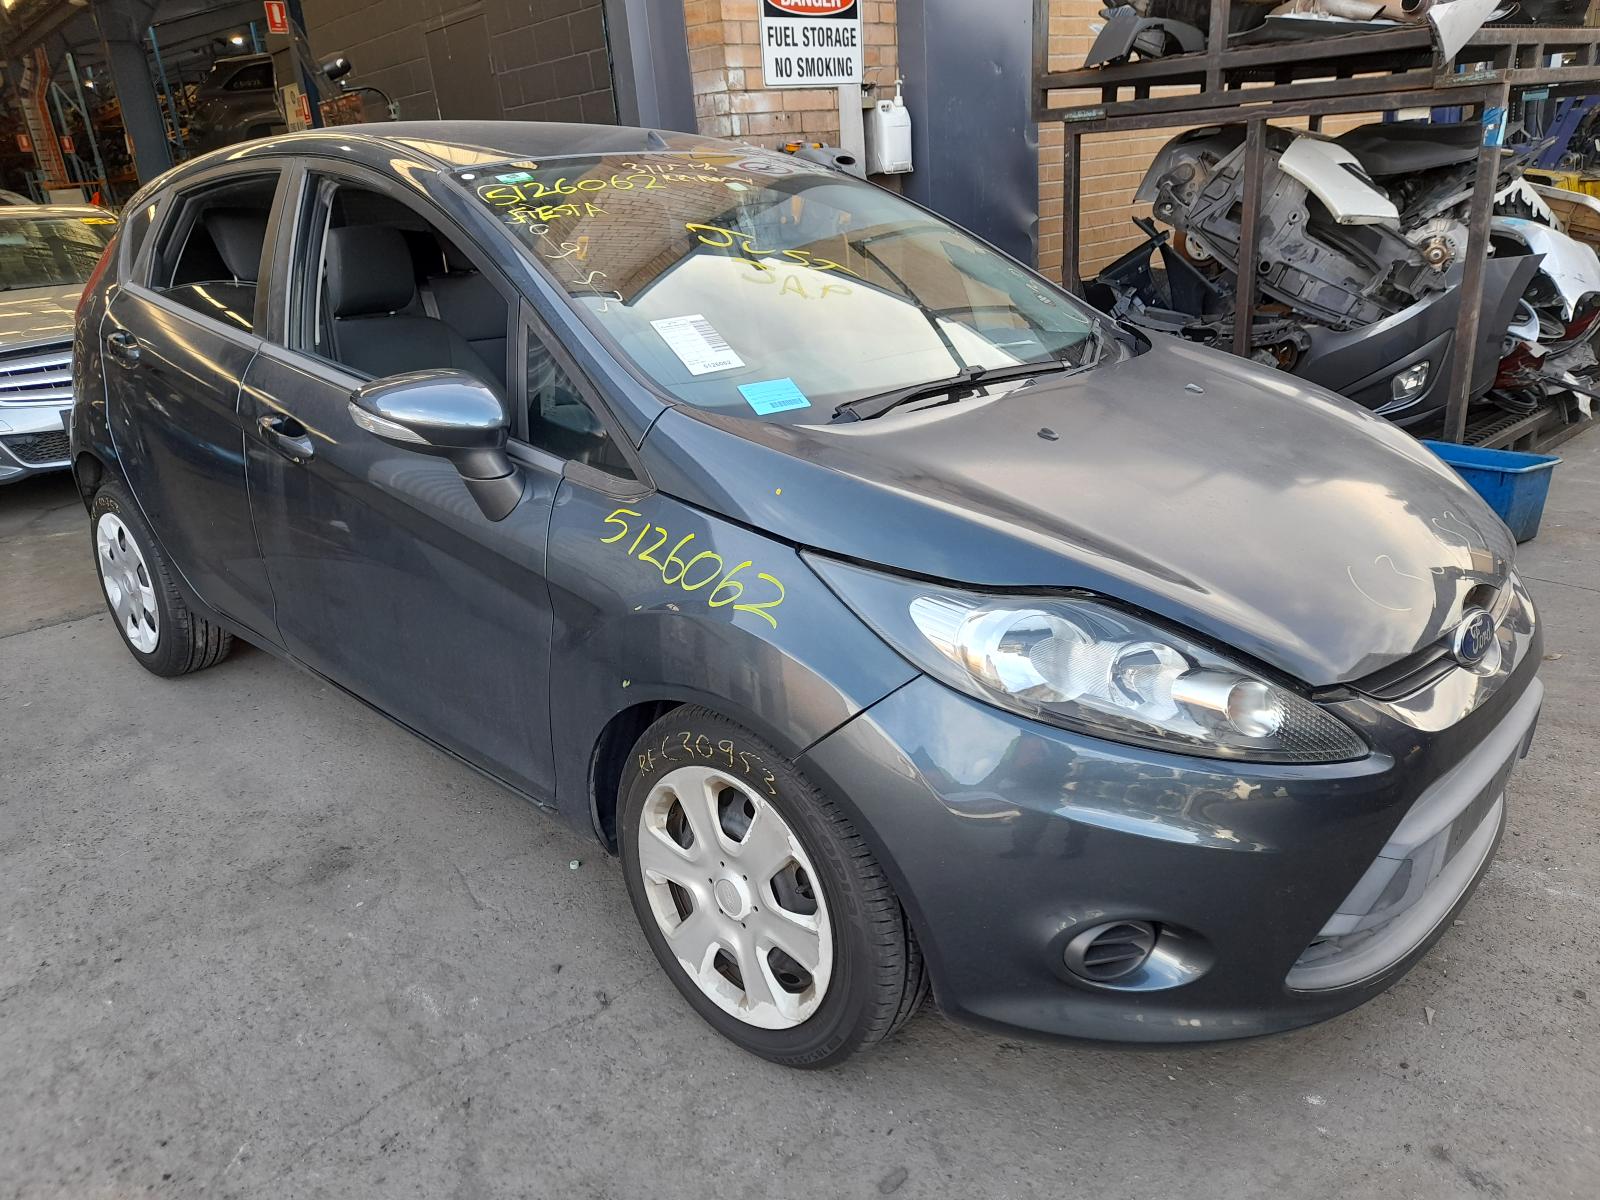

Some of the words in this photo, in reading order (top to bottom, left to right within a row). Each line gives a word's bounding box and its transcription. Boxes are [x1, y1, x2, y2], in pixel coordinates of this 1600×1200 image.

[767, 26, 798, 47] FUEL
[802, 26, 857, 48] STORAGE
[775, 57, 793, 78] NO
[797, 57, 853, 78] SMOKING
[484, 174, 667, 206] 5126062
[599, 508, 786, 630] 5126062
[1470, 617, 1491, 655] Ford
